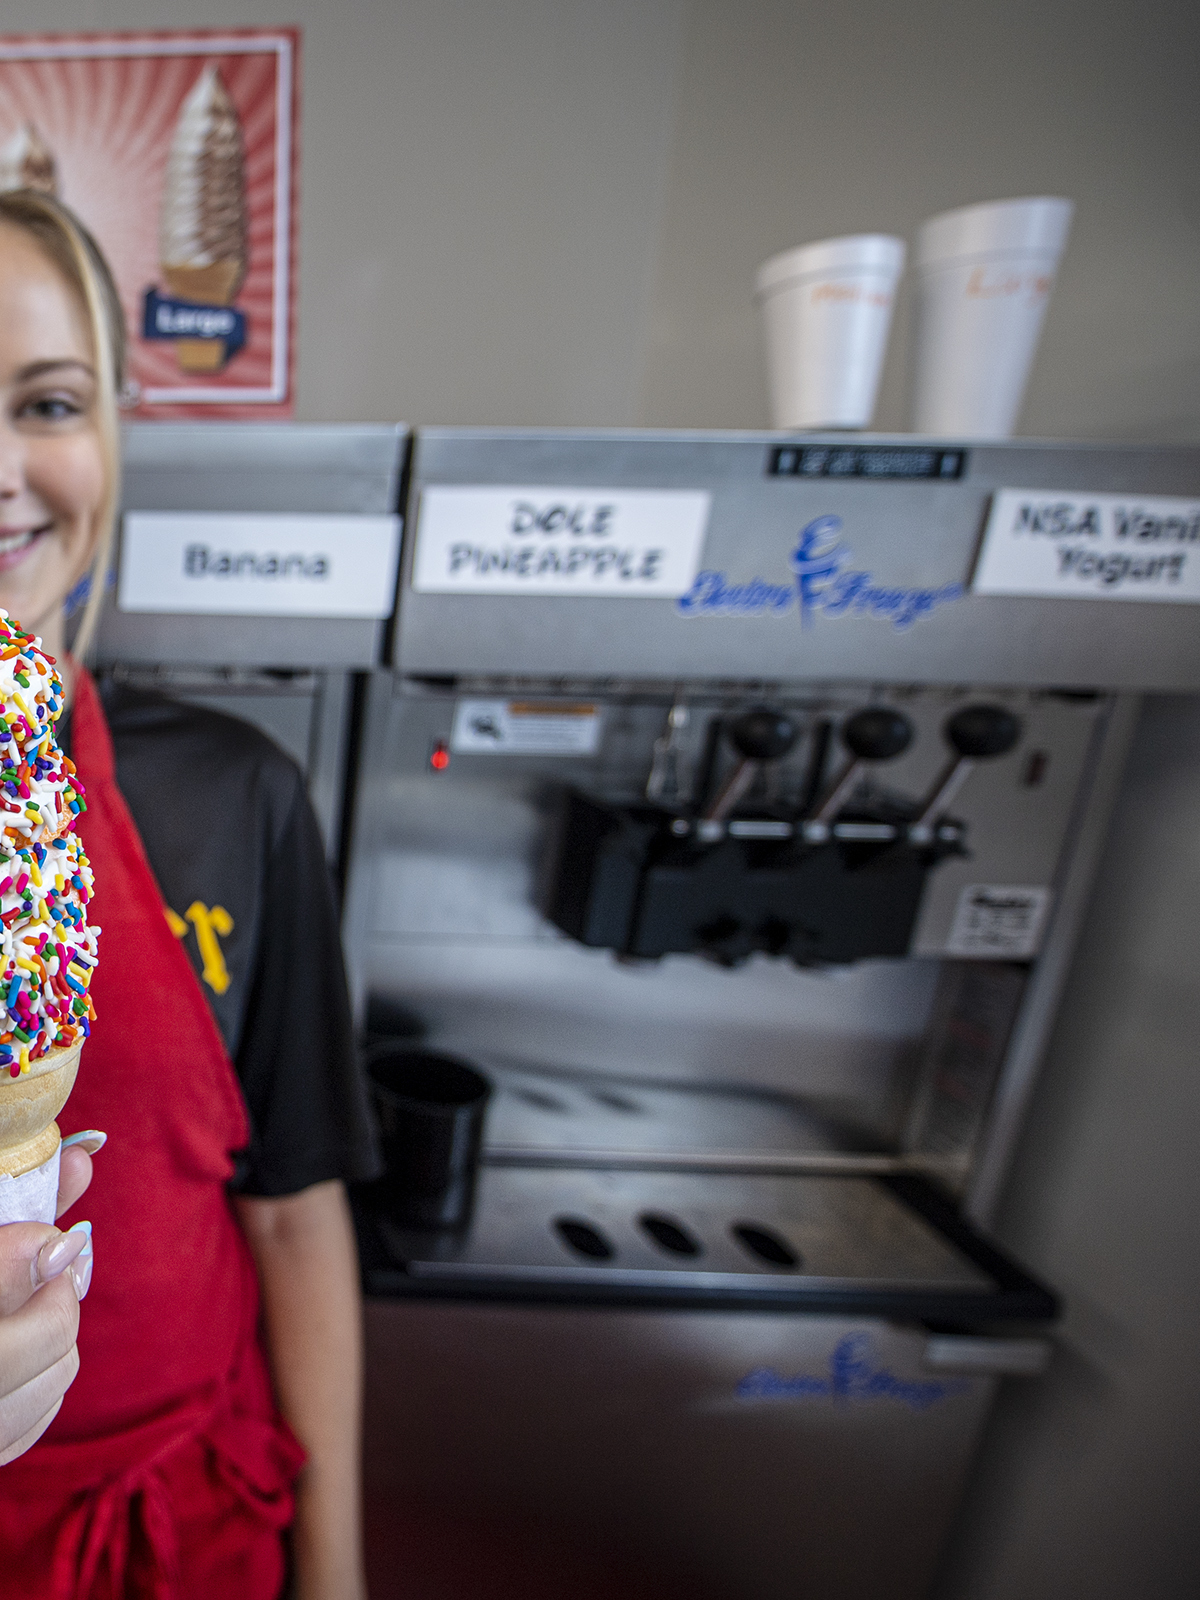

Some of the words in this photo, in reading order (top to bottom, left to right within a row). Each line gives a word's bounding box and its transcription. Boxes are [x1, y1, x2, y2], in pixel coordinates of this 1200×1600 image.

[157, 303, 236, 338] Large
[511, 502, 614, 536] DOLE
[1015, 502, 1101, 538] NSA
[184, 543, 331, 580] Banana
[449, 544, 662, 579] PINEAPPLE
[1058, 546, 1186, 586] Yogurt
